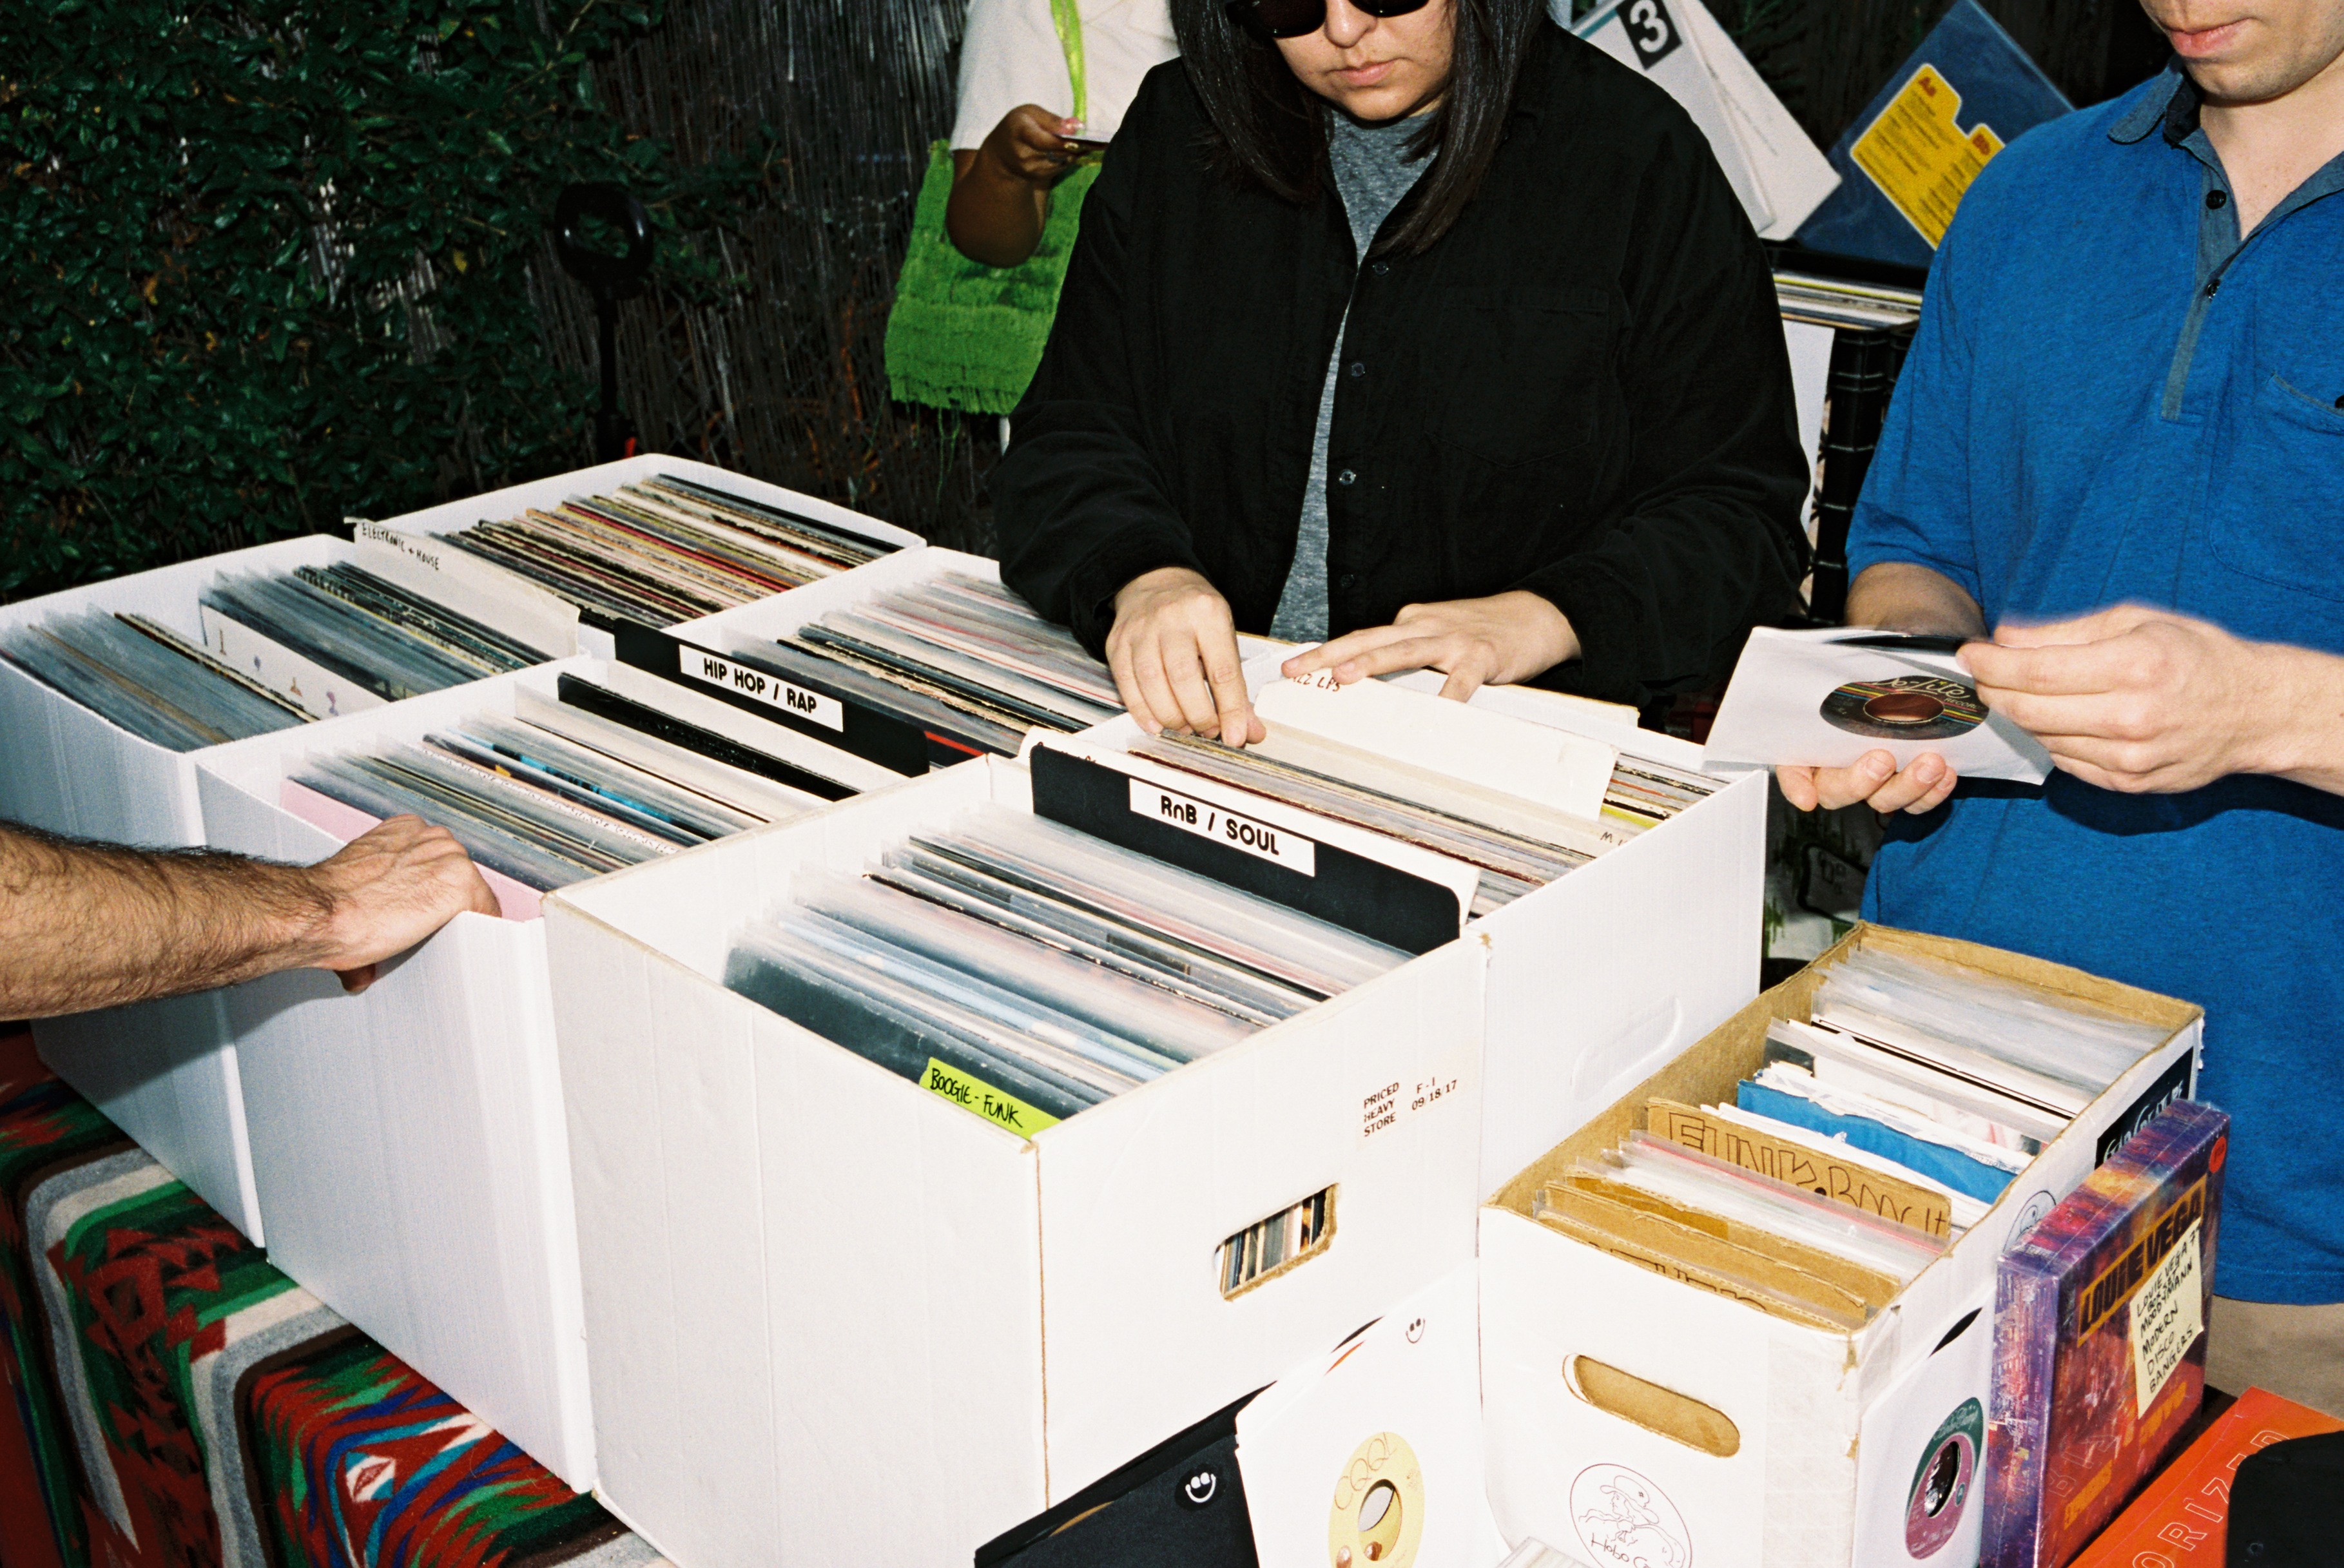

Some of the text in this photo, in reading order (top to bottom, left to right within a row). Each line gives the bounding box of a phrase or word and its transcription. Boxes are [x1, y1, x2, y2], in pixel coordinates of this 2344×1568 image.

[1630, 0, 1669, 53] 3
[362, 523, 405, 552] ELECTRONIC
[416, 549, 440, 570] HOUSE
[704, 657, 817, 713] HIP HOP / RAP
[1161, 795, 1279, 855] RnB / SOUL
[930, 1067, 972, 1104] BOOGIE
[983, 1094, 1023, 1128] FUNK
[1364, 1082, 1399, 1108] PRICED
[1364, 1079, 1457, 1137] STORE 09/18/17
[1364, 1098, 1395, 1123] HEAVY
[2145, 1185, 2202, 1271] VEGA
[2137, 1272, 2162, 1318] LOUIE
[2165, 1241, 2187, 1278] VEGA
[2140, 1257, 2193, 1339] MOODYMANN
[2142, 1299, 2178, 1360] MODERN
[2147, 1330, 2175, 1377] DISCO
[2149, 1322, 2193, 1394] BANGERS
[1591, 1533, 1630, 1562] Hobo
